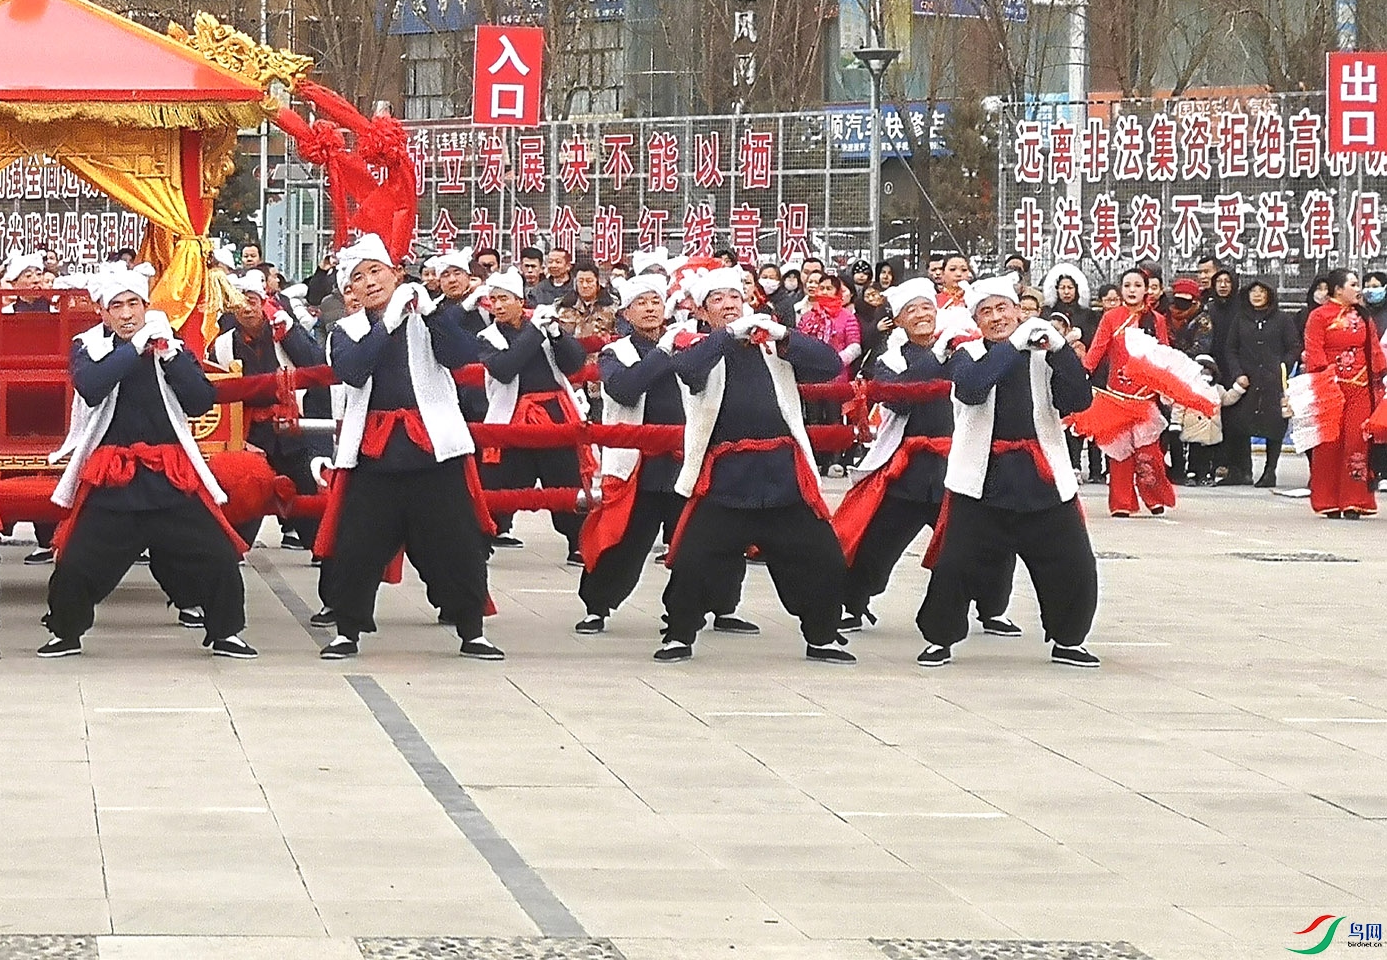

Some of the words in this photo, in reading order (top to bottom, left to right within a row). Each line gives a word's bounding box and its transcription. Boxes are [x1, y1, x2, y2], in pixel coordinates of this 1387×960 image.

[487, 34, 531, 119] 入口
[1340, 61, 1378, 145] 出口
[1014, 190, 1381, 262] 非法集资不受法律保
